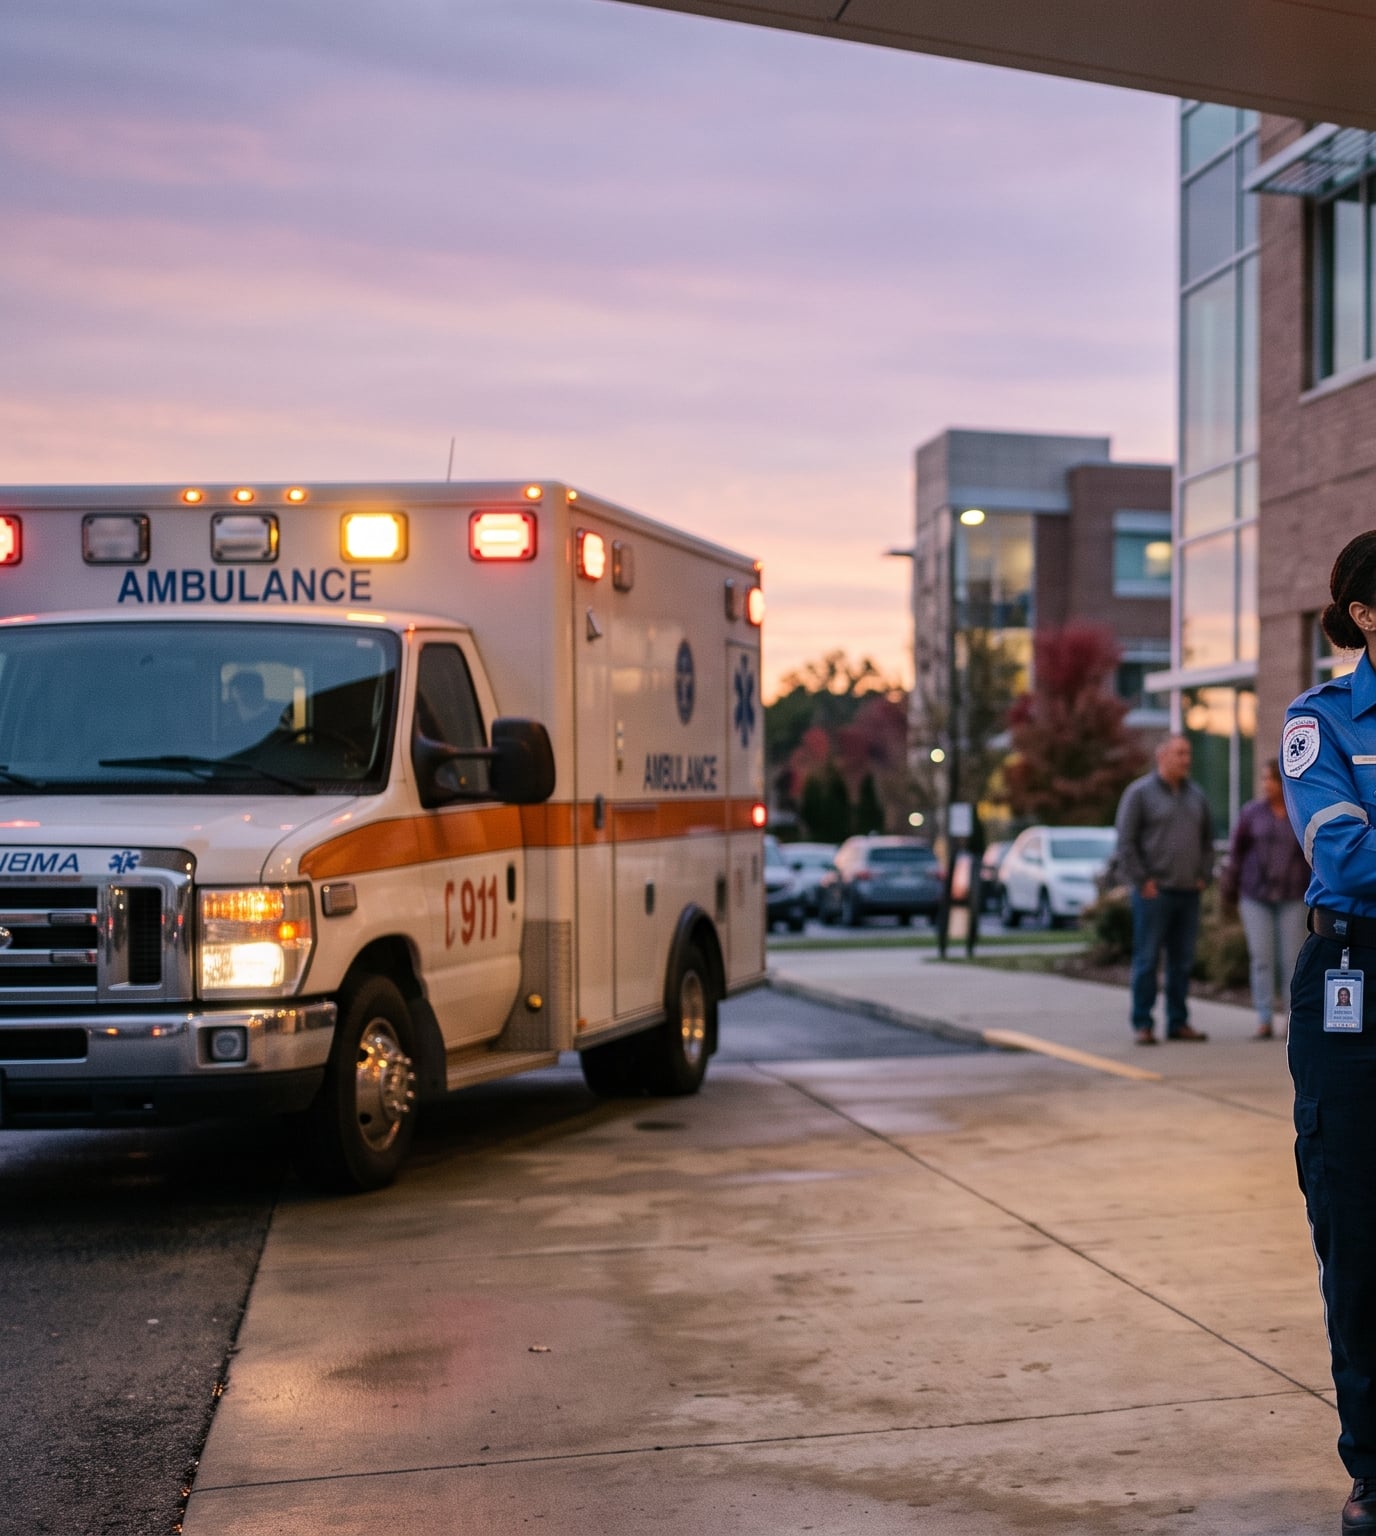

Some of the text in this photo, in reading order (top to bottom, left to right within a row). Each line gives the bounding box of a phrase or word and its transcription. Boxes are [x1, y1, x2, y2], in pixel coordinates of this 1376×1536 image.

[117, 568, 372, 604] AMBULANCE
[643, 753, 718, 792] AMBULANCE
[461, 874, 498, 946] 911
